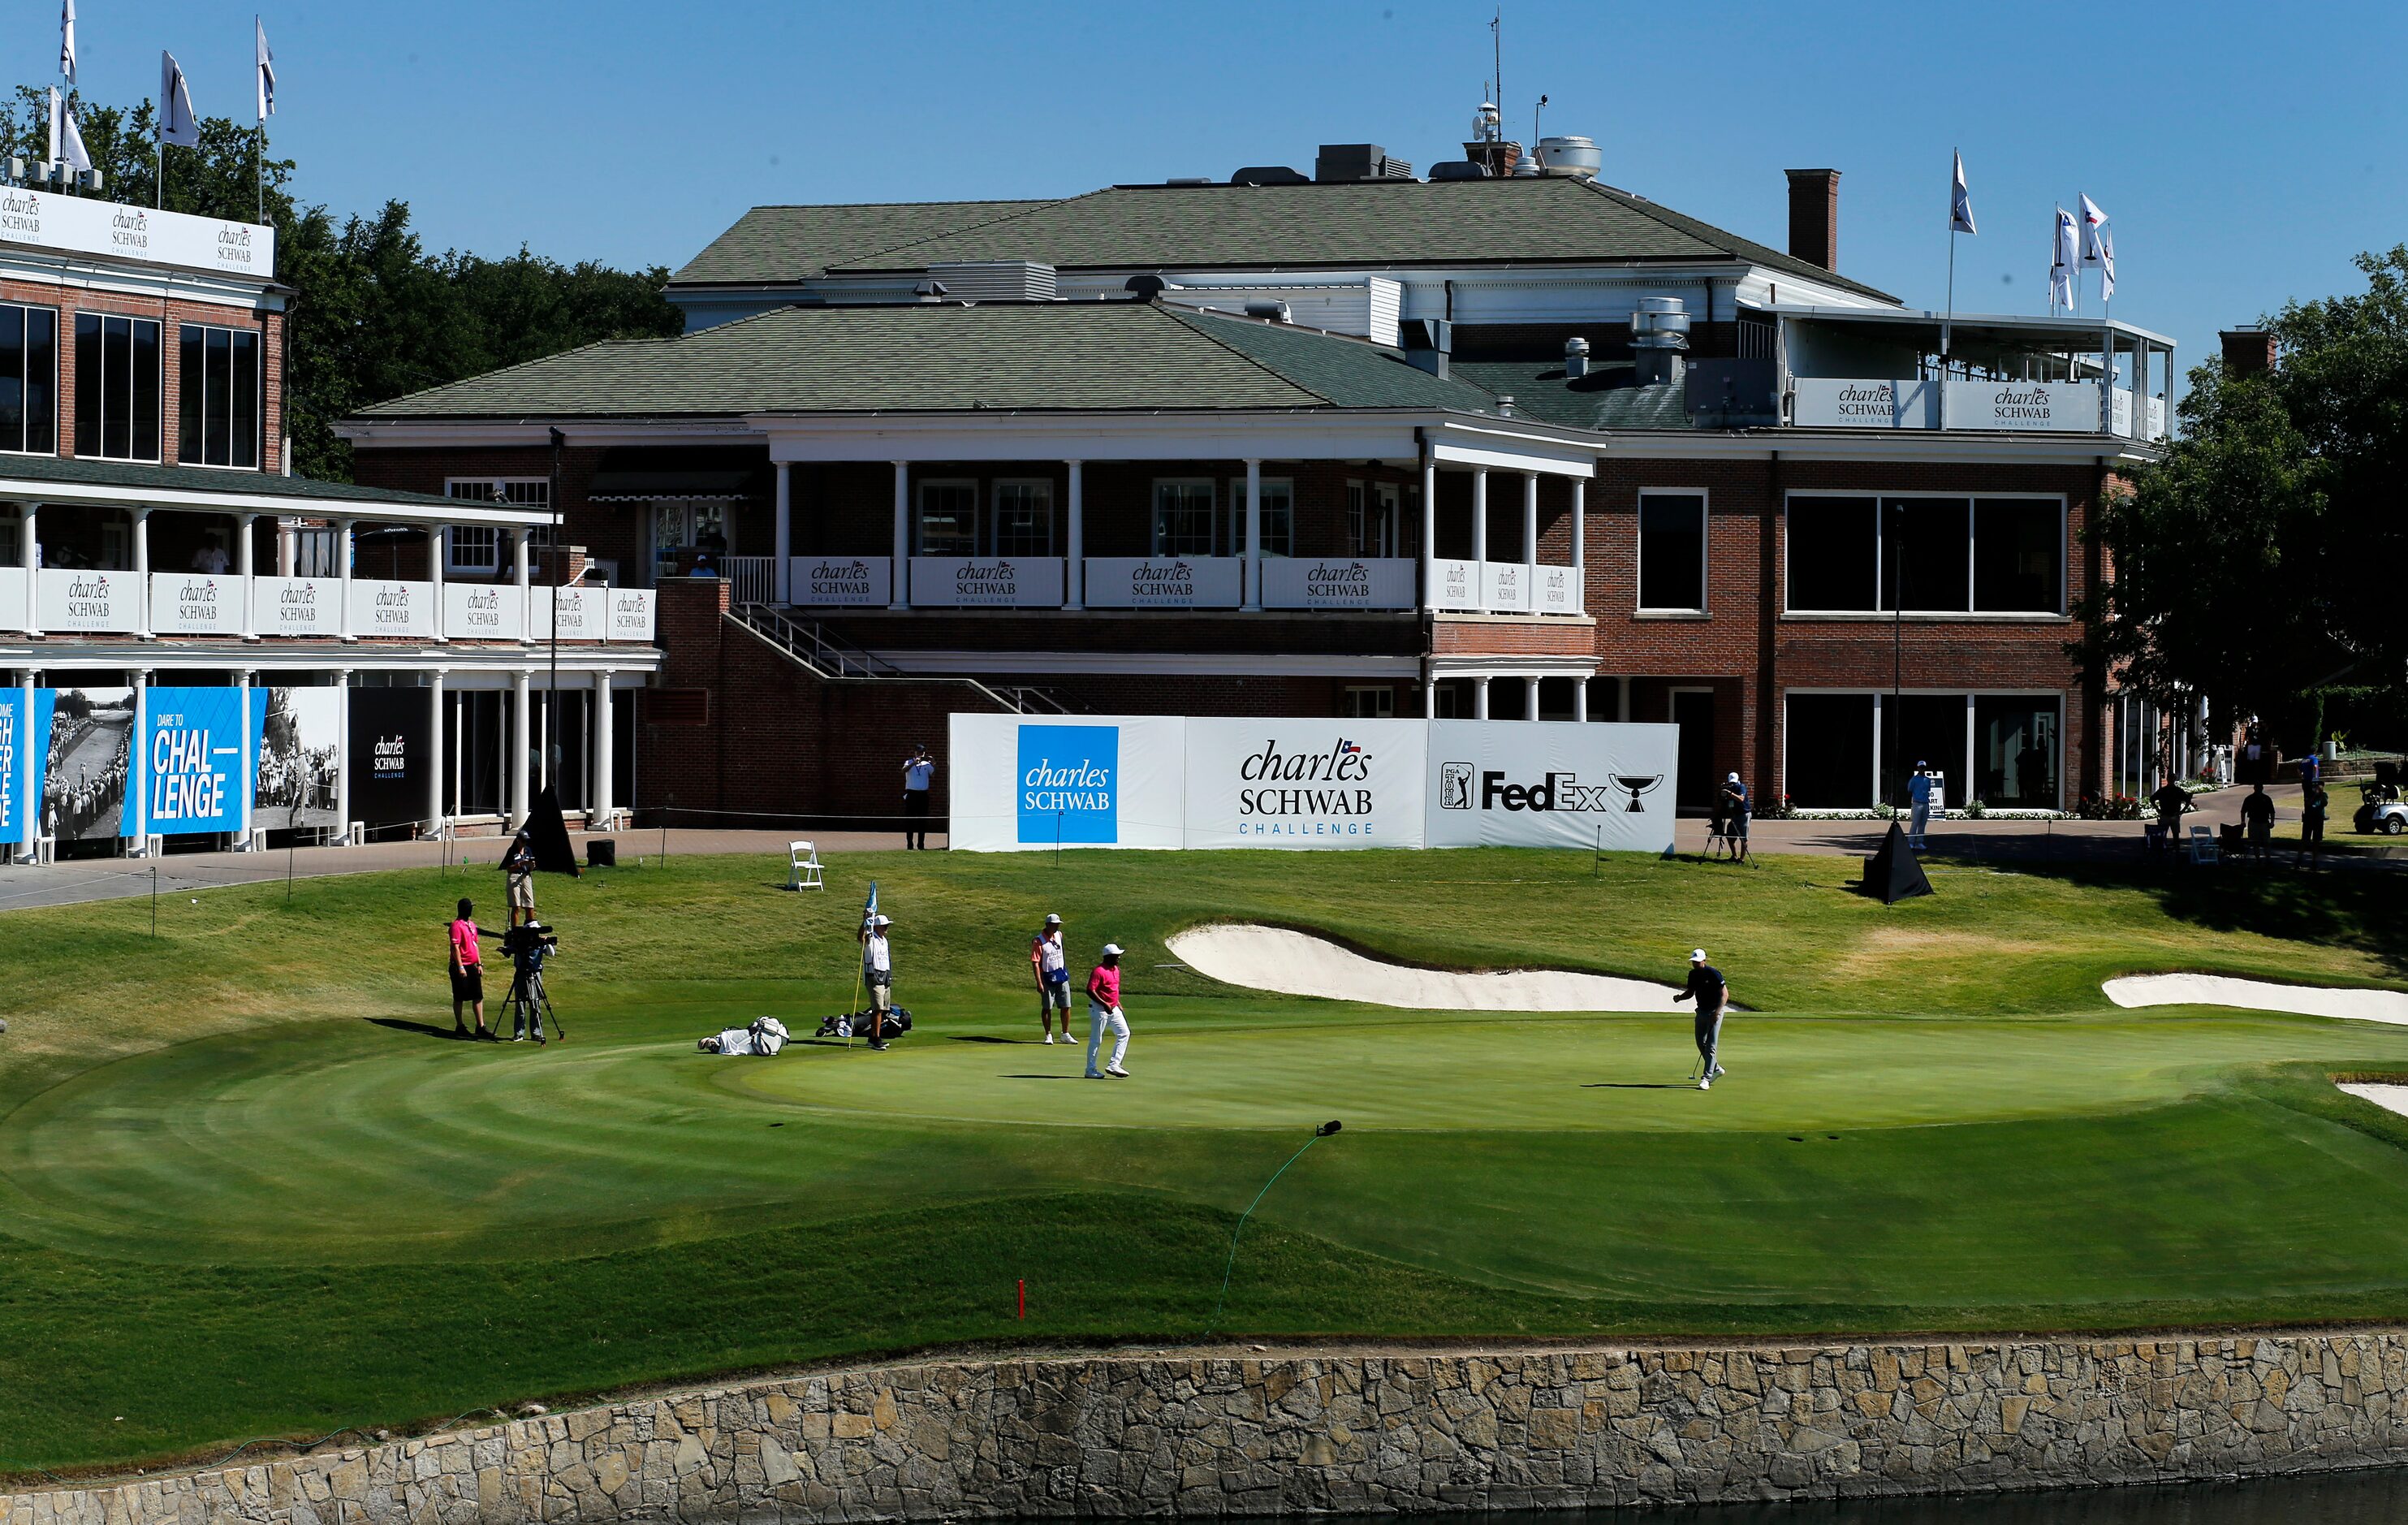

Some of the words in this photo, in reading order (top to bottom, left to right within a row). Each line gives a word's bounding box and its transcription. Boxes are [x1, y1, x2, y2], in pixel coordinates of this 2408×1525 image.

[2, 191, 40, 215] charles
[2, 215, 40, 232] SCHWAB
[113, 208, 147, 231] charles
[1, 231, 40, 242] CHALLENGE
[112, 231, 148, 248] SCHWAB
[218, 224, 251, 247] charles
[111, 247, 148, 257] CHALLENGE
[218, 246, 251, 262] SCHWAB
[217, 261, 251, 272] CHALLENGE
[1839, 385, 1894, 402] charles
[1995, 387, 2050, 404] charles
[1839, 404, 1895, 416] SCHWAB
[1995, 407, 2050, 419] SCHWAB
[811, 559, 869, 580] charles
[956, 560, 1015, 580] charles
[1133, 561, 1192, 581] charles
[1308, 562, 1368, 581] charles
[1447, 564, 1465, 583] charles
[1499, 567, 1516, 585] charles
[68, 576, 110, 598] charles
[811, 582, 870, 594] SCHWAB
[956, 582, 1016, 594] SCHWAB
[1547, 570, 1564, 589] charles
[180, 579, 218, 602] charles
[281, 582, 316, 604] charles
[376, 585, 409, 607] charles
[1133, 583, 1193, 595] SCHWAB
[1307, 584, 1369, 596] SCHWAB
[1447, 585, 1465, 598] SCHWAB
[1498, 588, 1516, 600] SCHWAB
[1547, 590, 1564, 603] SCHWAB
[468, 589, 498, 610] charles
[555, 591, 582, 611] harles
[617, 593, 646, 612] charles
[68, 603, 110, 617] SCHWAB
[179, 605, 217, 620] SCHWAB
[280, 607, 316, 621] SCHWAB
[375, 610, 409, 624] SCHWAB
[467, 612, 498, 625] SCHWAB
[556, 615, 582, 627] CHWAB
[617, 616, 645, 628] SCHWAB
[158, 714, 174, 727] DARE
[175, 714, 183, 727] TO
[375, 734, 404, 755] charles
[374, 757, 404, 771] SCHWAB
[1240, 737, 1373, 781] charles
[1025, 758, 1110, 788] charles
[153, 774, 227, 819] LENGE
[1444, 774, 1455, 806] TOUR
[1482, 771, 1607, 812] FedEx
[1025, 791, 1110, 811] SCHWAB
[1239, 788, 1373, 814] SCHWAB
[1239, 822, 1373, 835] CHALLENGE
